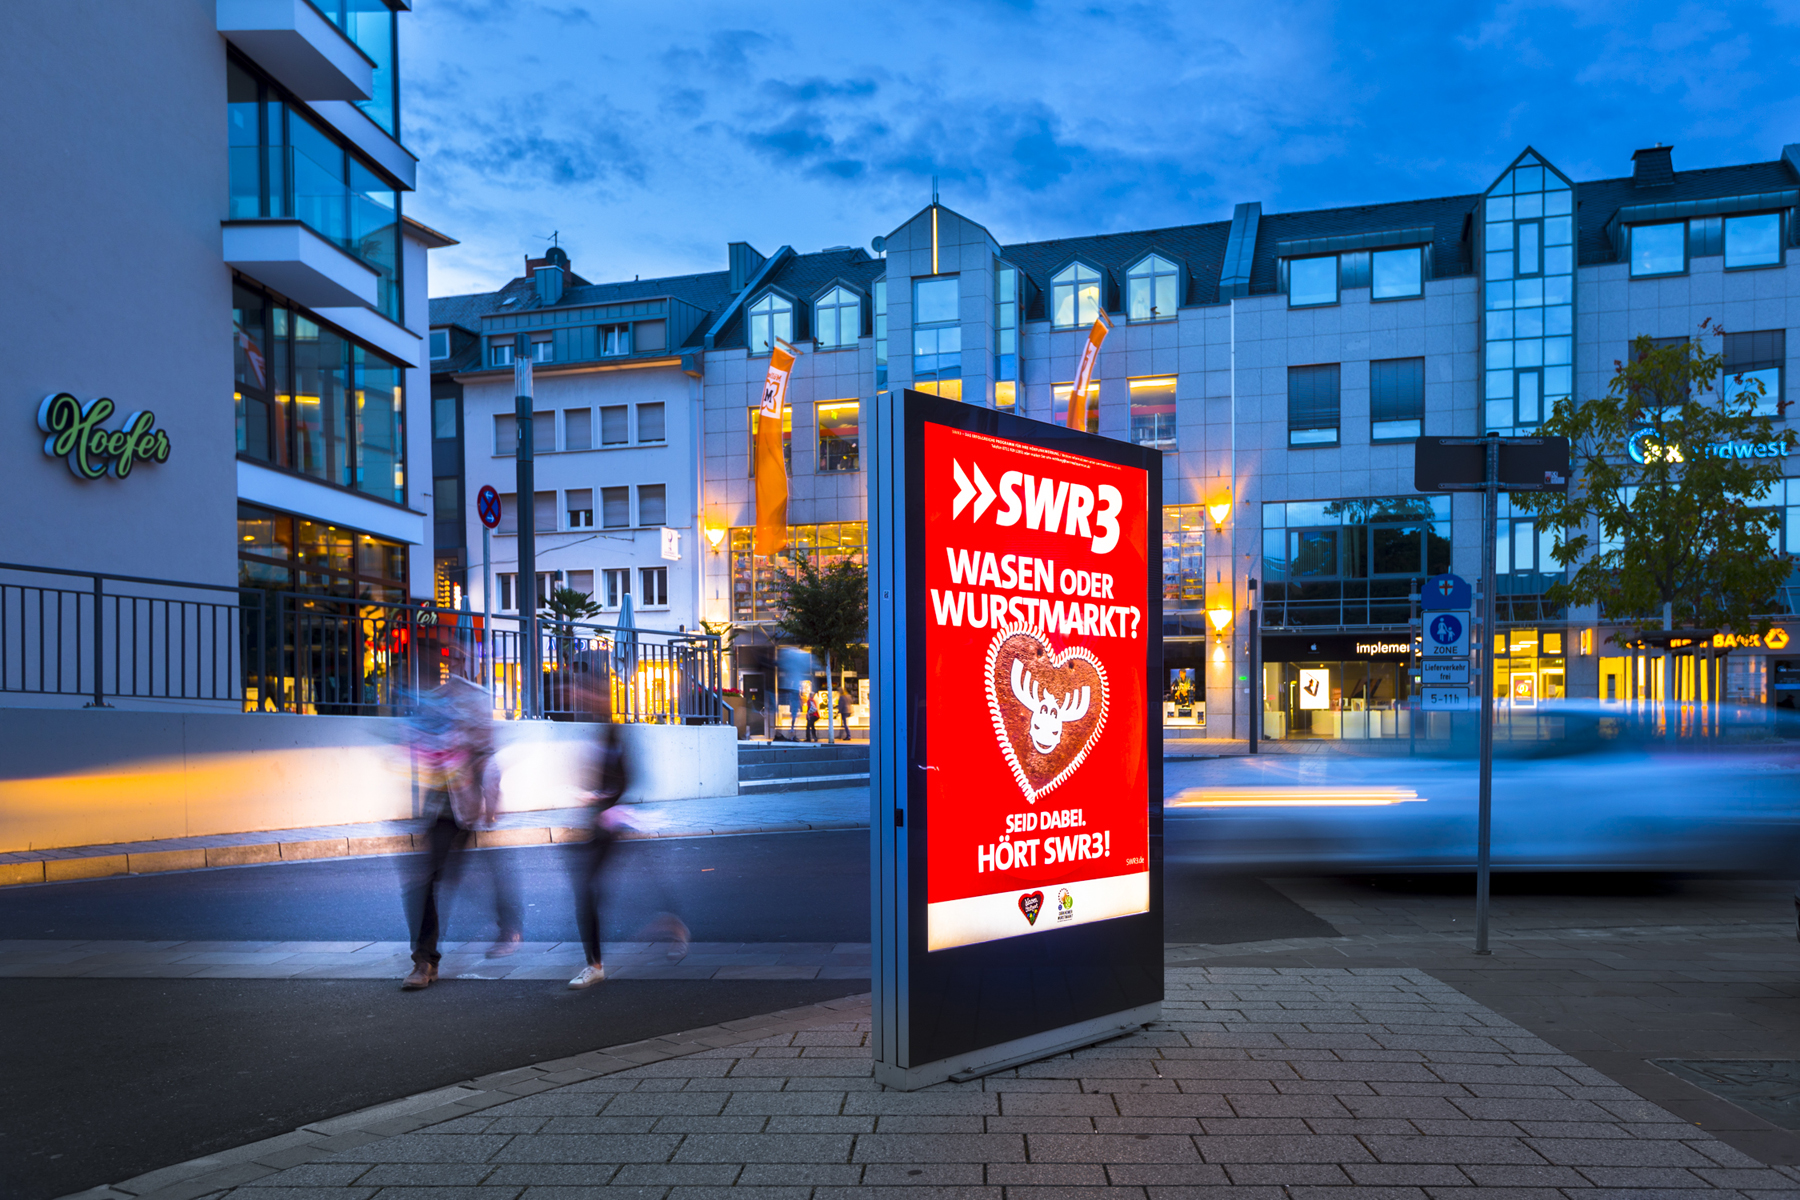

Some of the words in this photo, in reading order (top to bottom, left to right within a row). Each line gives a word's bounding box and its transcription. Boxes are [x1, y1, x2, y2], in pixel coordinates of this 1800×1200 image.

[44, 392, 171, 479] Hoefer
[1692, 441, 1789, 459] dwest
[996, 470, 1123, 554] SWR3
[946, 547, 1054, 593] WASEN
[1060, 568, 1114, 599] ODER
[930, 588, 1141, 639] WURSTMARKT?
[1433, 646, 1458, 654] ZONE
[1440, 672, 1451, 680] frei
[1005, 812, 1038, 834] SEID
[1040, 808, 1086, 831] DABEI.
[978, 834, 1040, 873] HÖRT
[1044, 830, 1110, 865] SWR3!
[1126, 856, 1145, 866] SWR3.de
